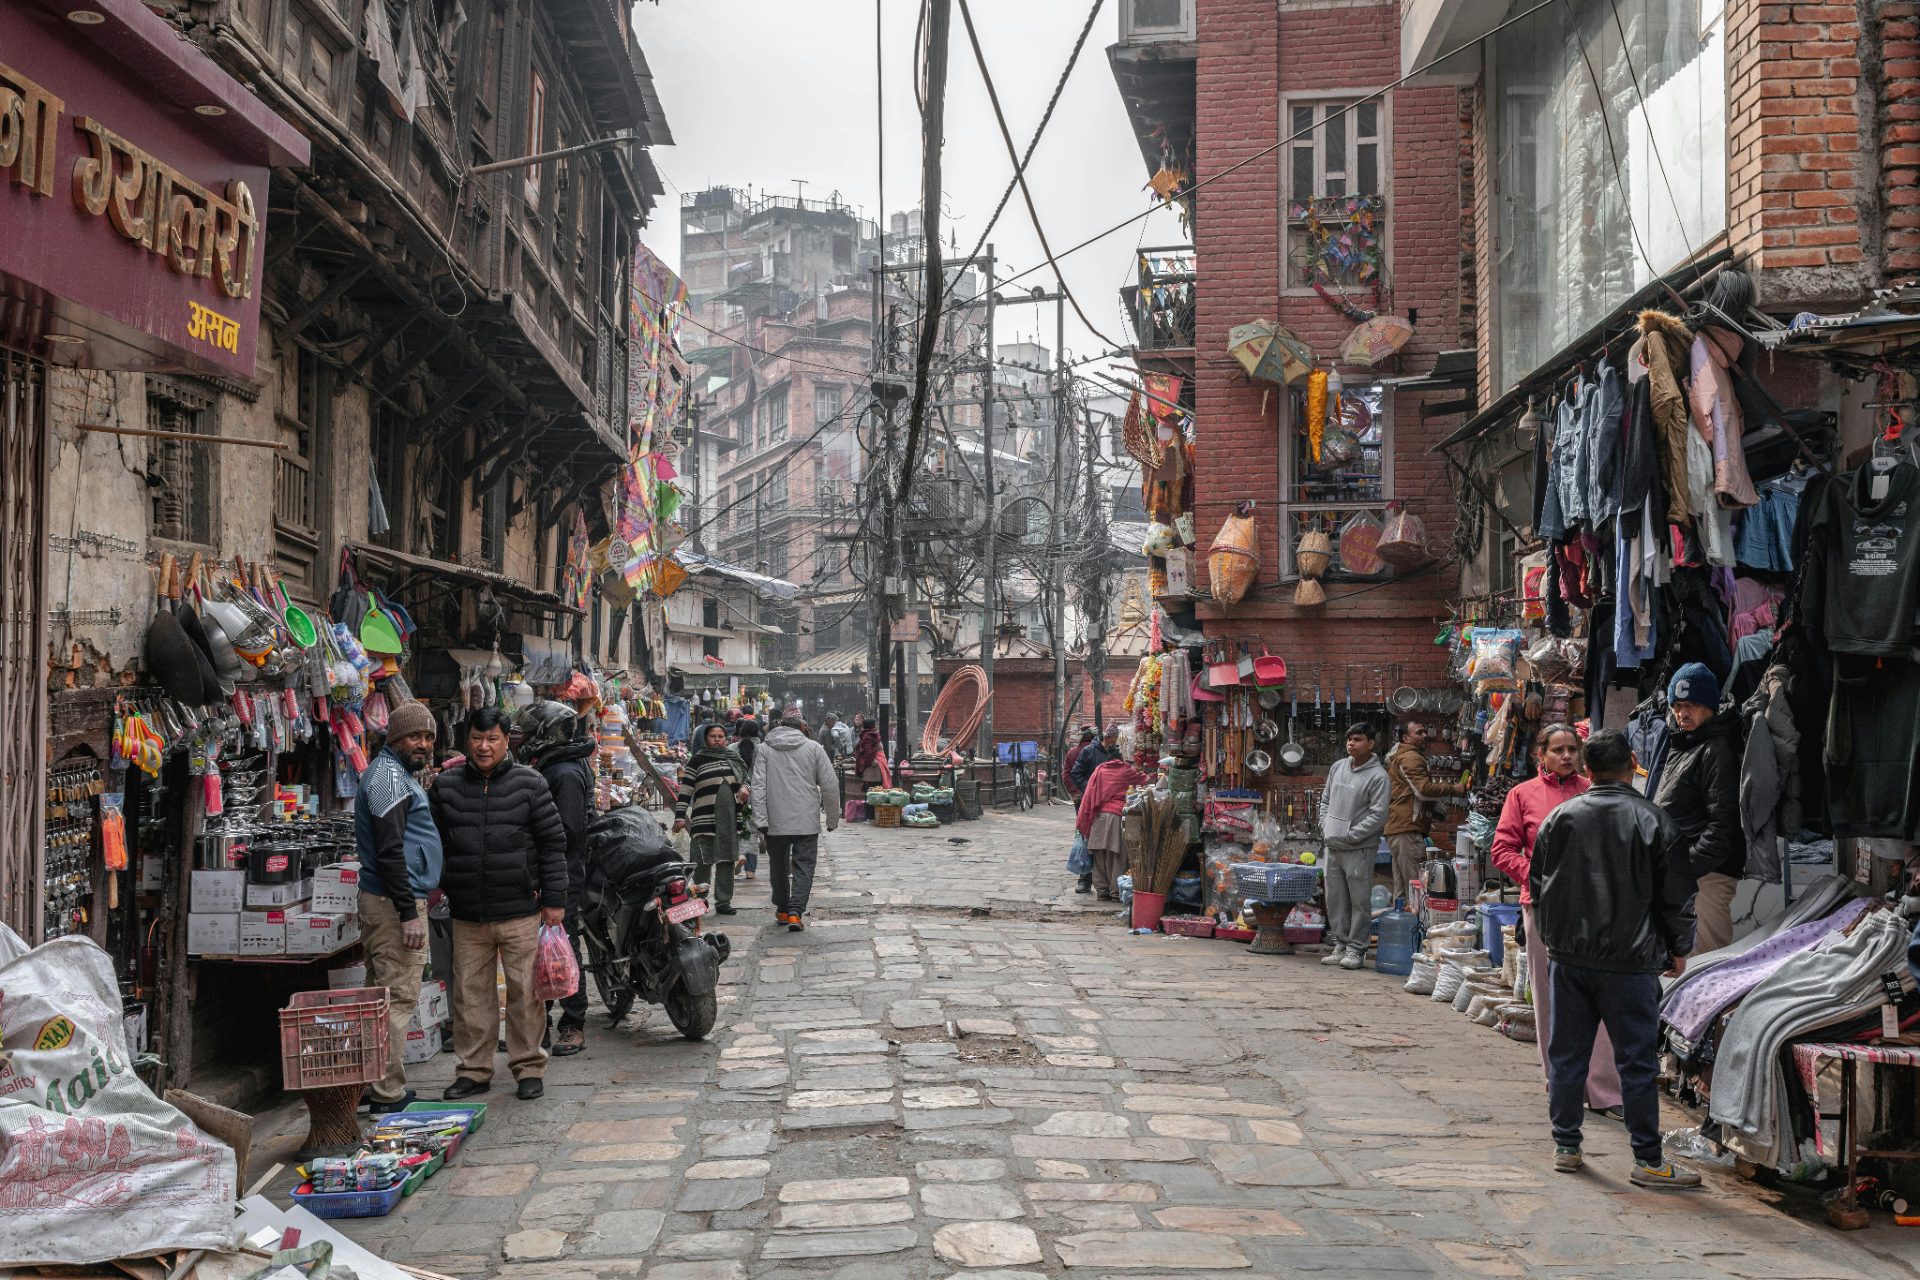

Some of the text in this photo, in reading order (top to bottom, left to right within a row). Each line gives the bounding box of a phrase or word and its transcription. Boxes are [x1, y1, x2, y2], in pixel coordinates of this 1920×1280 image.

[72, 115, 260, 300] ग्यालरी
[187, 300, 241, 355] असन
[1675, 680, 1690, 698] C
